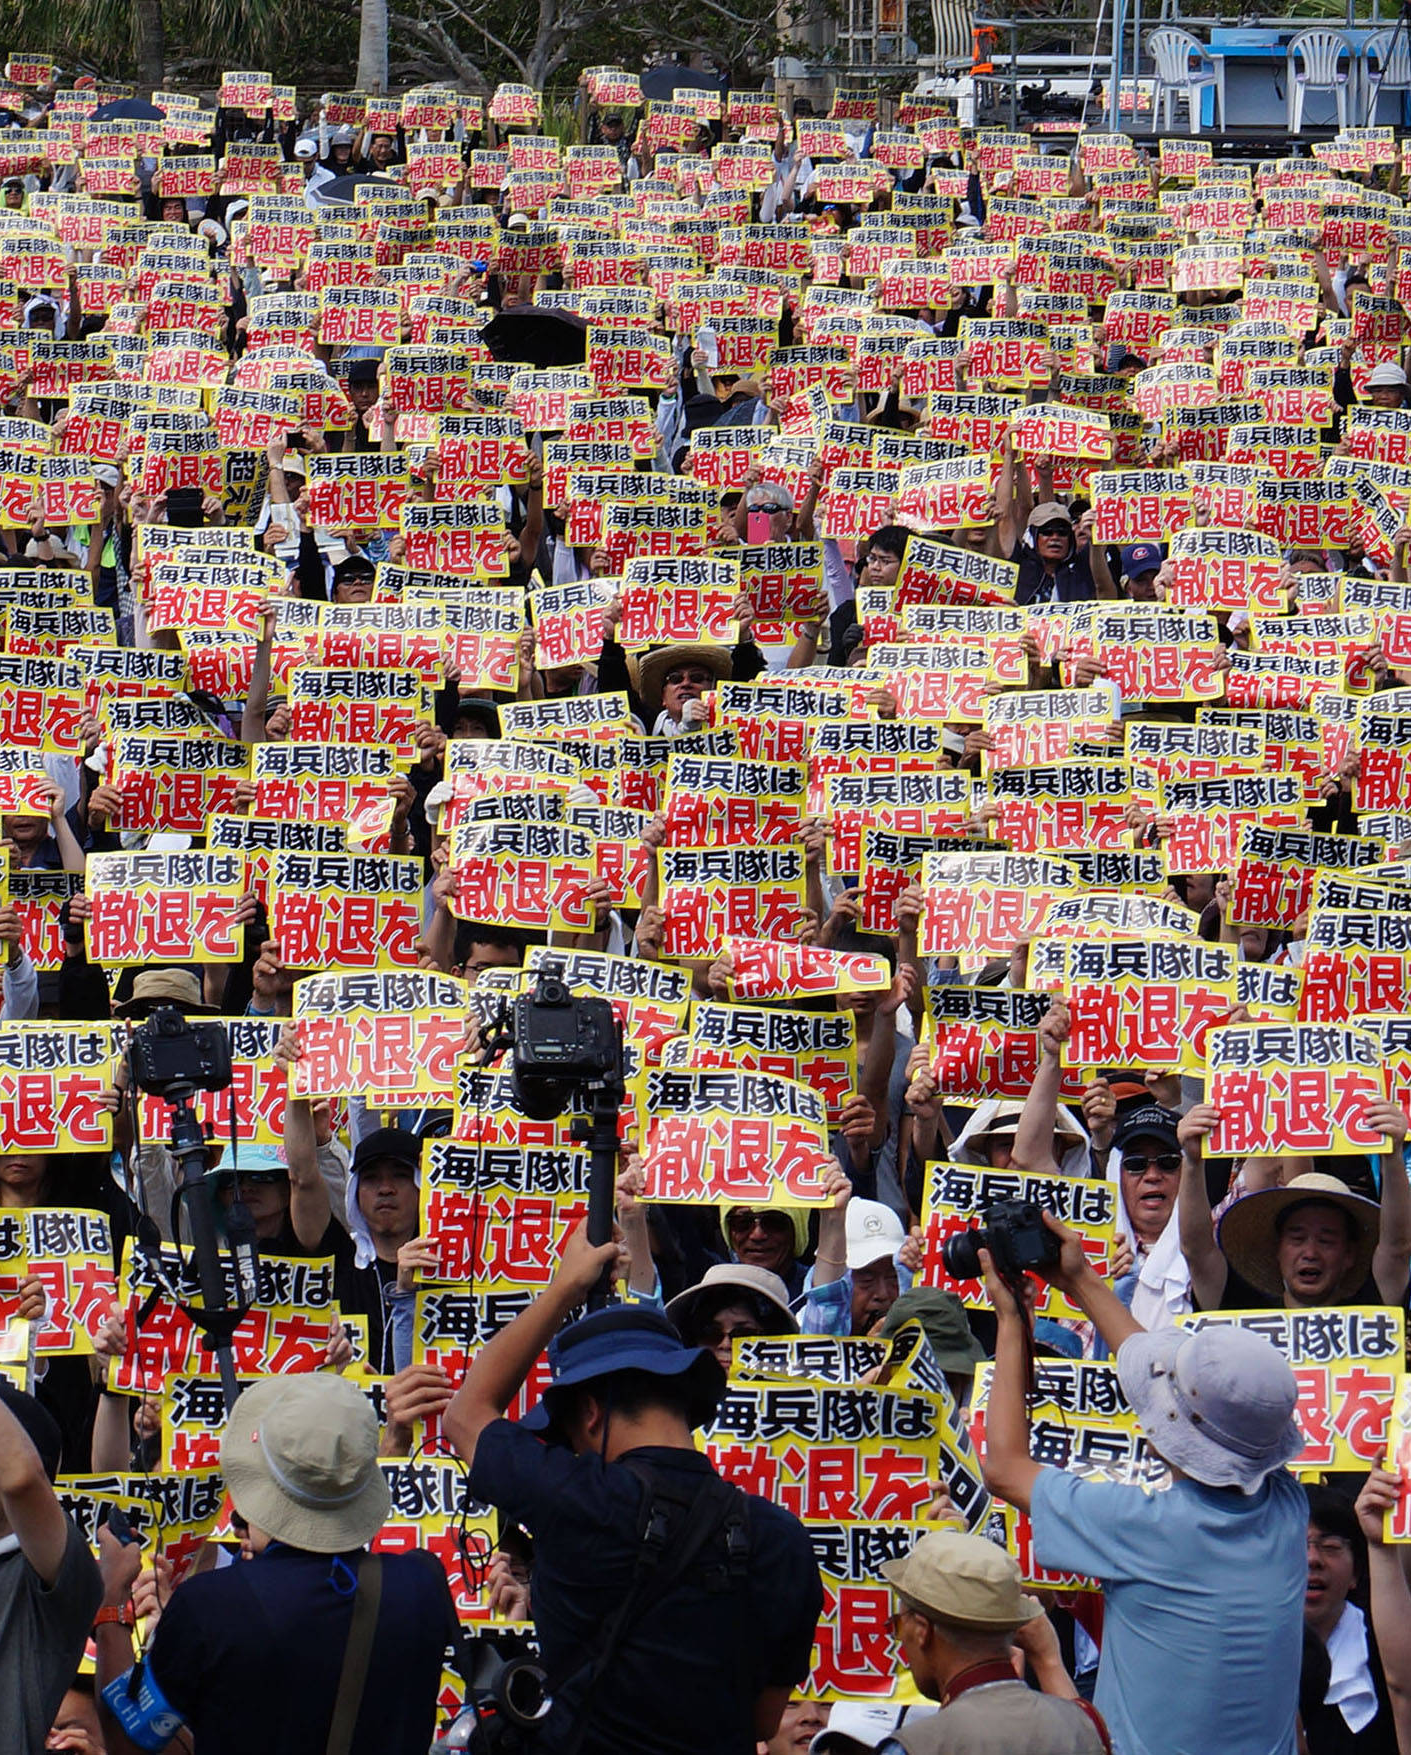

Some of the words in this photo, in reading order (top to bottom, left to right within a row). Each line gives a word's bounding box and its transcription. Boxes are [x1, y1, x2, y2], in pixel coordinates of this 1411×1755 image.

[225, 74, 271, 83] 海兵隊は
[224, 86, 271, 105] 撤退を
[650, 103, 696, 114] 海兵隊は
[649, 117, 695, 136] 撤退を
[227, 144, 277, 155] 海兵隊は
[569, 147, 615, 158] 海兵隊は
[226, 158, 277, 180] 撤退を
[569, 160, 620, 180] 撤退を
[141, 254, 206, 270] 海兵隊は
[156, 284, 217, 300] 海兵隊は
[1248, 281, 1316, 298] 海兵隊は
[147, 305, 218, 332] 撤退を
[1245, 301, 1313, 325] 撤退を
[149, 352, 225, 384] 撤退を
[1251, 369, 1329, 386] 海兵隊は
[218, 389, 299, 413] 海兵隊は
[439, 416, 523, 436] 海兵隊は
[1016, 421, 1108, 455] 撤退を
[439, 439, 528, 481] 撤退を
[1094, 472, 1188, 494] 海兵隊は
[404, 505, 502, 528] 海兵隊は
[1096, 496, 1190, 541] 撤退を
[406, 530, 506, 575] 撤退を
[1174, 531, 1279, 556] 海兵隊は
[627, 560, 736, 586] 海兵隊は
[1171, 558, 1283, 607] 撤退を
[619, 588, 734, 642] 撤退を
[1098, 615, 1216, 642] 海兵隊は
[293, 671, 419, 697] 海兵隊は
[1099, 645, 1217, 701] 撤退を
[723, 686, 847, 717] 海兵隊は
[119, 737, 247, 768] 海兵隊は
[1130, 725, 1262, 757] 海兵隊は
[257, 745, 393, 776] 海兵隊は
[670, 758, 803, 794] 海兵隊は
[831, 776, 965, 804] 海兵隊は
[993, 766, 1127, 798] 海兵隊は
[1165, 778, 1298, 809] 海兵隊は
[111, 771, 236, 832] 撤退を
[455, 823, 592, 858] 海兵隊は
[1242, 823, 1385, 867] 海兵隊は
[90, 854, 239, 886] 海兵隊は
[274, 855, 420, 893] 海兵隊は
[664, 849, 802, 884] 海兵隊は
[927, 853, 1079, 888] 海兵隊は
[453, 856, 591, 925] 撤退を
[88, 888, 239, 960] 撤退を
[272, 891, 422, 965] 撤退を
[1309, 913, 1411, 951] 海兵隊
[1070, 941, 1235, 981] 海兵隊は
[295, 972, 466, 1014] 海兵隊は
[1299, 949, 1411, 1022] 撤退
[932, 989, 1050, 1028] 海兵隊
[693, 1007, 852, 1051] 海兵隊は
[293, 1014, 466, 1094] 撤退を
[932, 1021, 1037, 1098] 撤退
[1211, 1027, 1379, 1069] 海兵隊は
[646, 1071, 824, 1118] 海兵隊は
[1209, 1069, 1386, 1153] 撤退を
[643, 1119, 834, 1201] 撤退を
[704, 1391, 936, 1438] 海兵隊は
